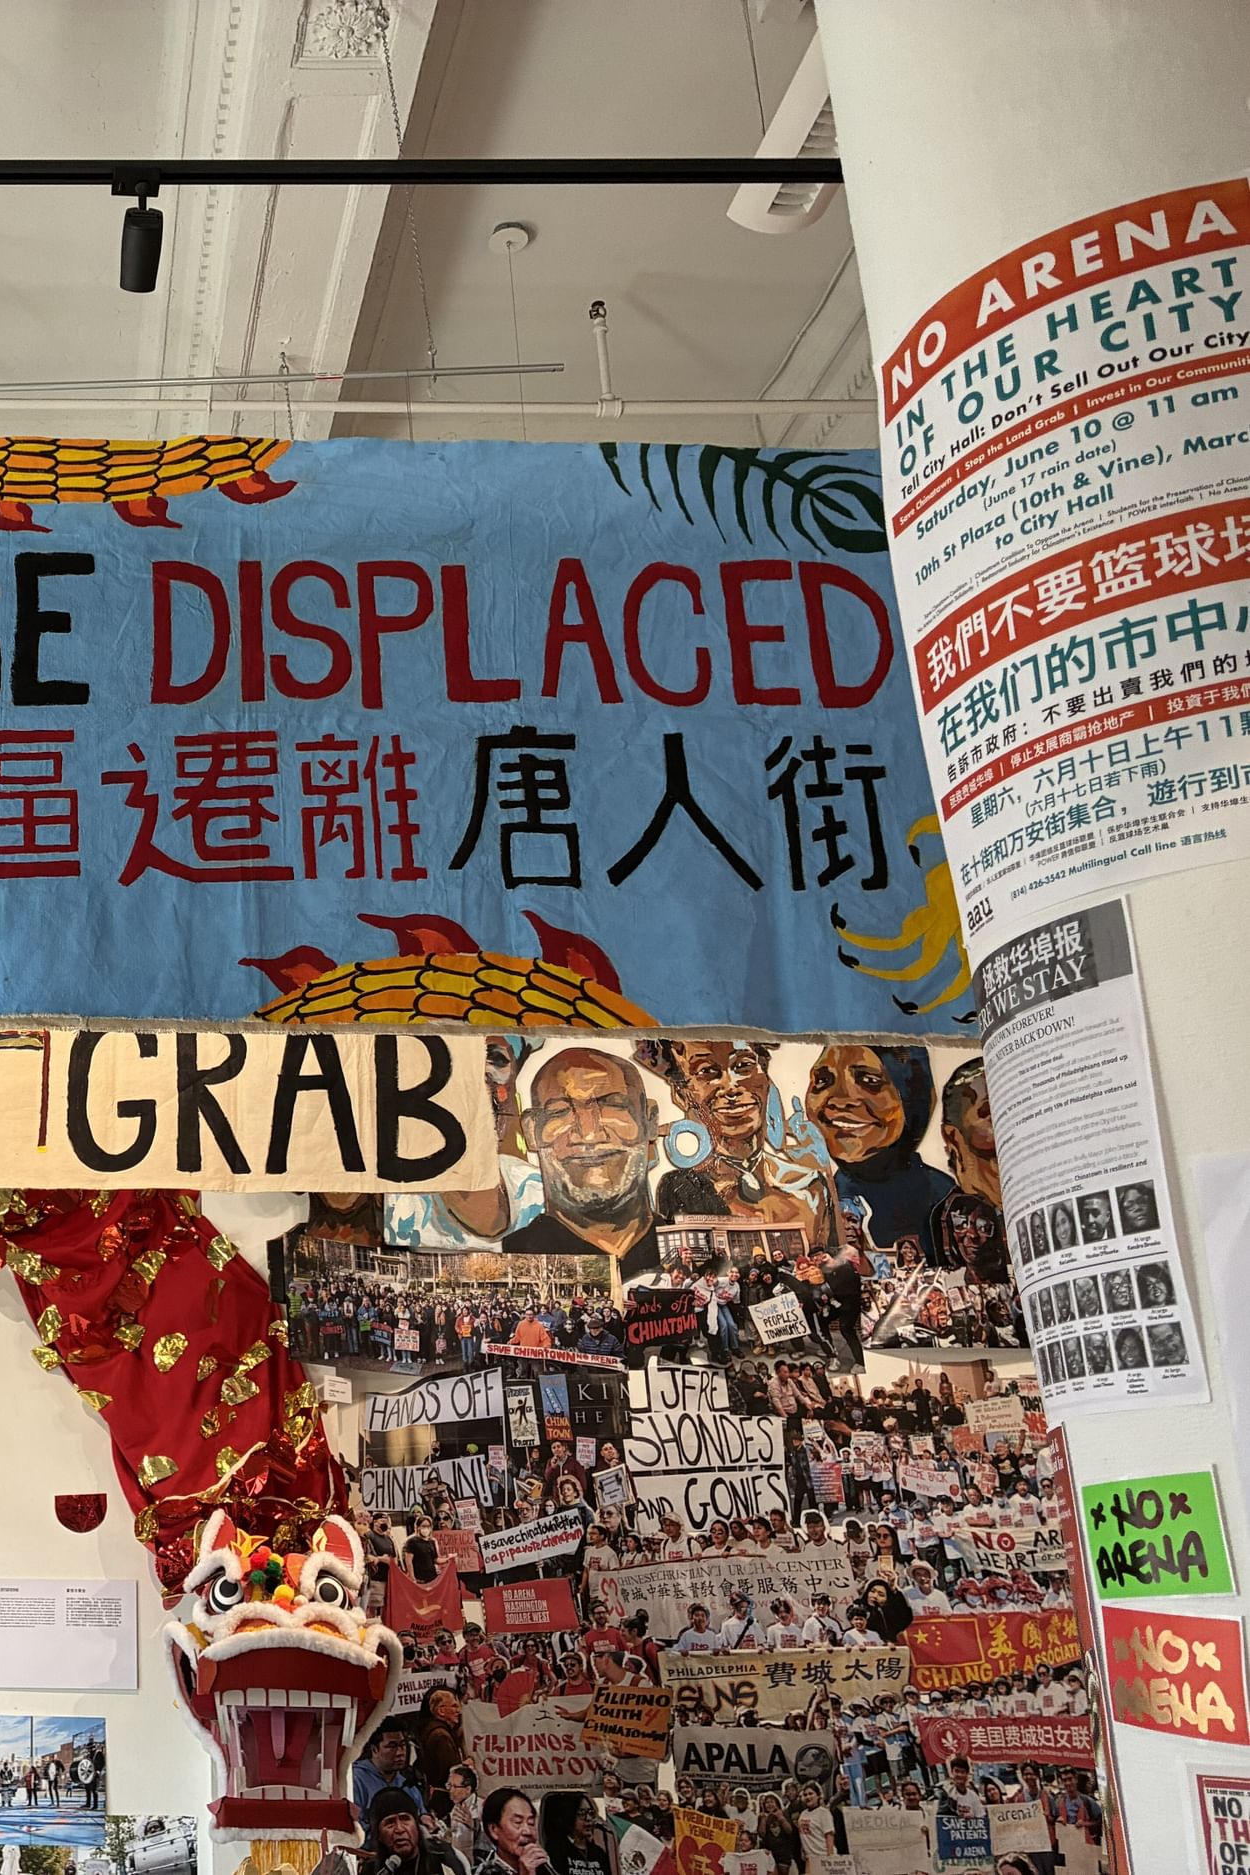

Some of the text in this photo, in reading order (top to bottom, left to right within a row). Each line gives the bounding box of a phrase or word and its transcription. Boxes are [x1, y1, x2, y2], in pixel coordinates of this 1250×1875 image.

[891, 199, 1238, 405] NO ARENA
[896, 257, 1237, 448] IN THE HEART
[900, 291, 1242, 477] OF OUR CITY
[900, 331, 1250, 500] Tell City Hall: Don't Sell Out Our City
[899, 509, 915, 526] Save
[915, 476, 952, 510] Chinatown
[964, 454, 985, 472] Stop
[987, 441, 1004, 457] the
[1005, 424, 1032, 446] Land
[1034, 410, 1066, 431] Grab
[1086, 388, 1126, 408] Invest
[1129, 383, 1142, 397] in
[1146, 375, 1173, 388] Our
[916, 386, 1239, 540] Saturday, June 10 @ 11 am
[983, 439, 1116, 512] (June 17 rain date)
[914, 424, 1250, 586] 10th St Plaza (10th & Vine), Marc
[1074, 517, 1095, 530] Arena
[1107, 503, 1138, 517] Students
[1139, 498, 1150, 509] for
[1152, 493, 1164, 504] the
[1166, 482, 1214, 499] Preservation
[1216, 478, 1224, 488] of
[1128, 504, 1157, 518] POWER
[1224, 483, 1249, 495] Arena
[995, 483, 1113, 550] to City Hall
[151, 557, 894, 711] DISPLACED
[938, 597, 1250, 758] 在我们的市中
[1068, 850, 1127, 877] Multilingual
[1130, 843, 1152, 857] Call
[1155, 840, 1177, 852] line
[993, 982, 1021, 1018] WE
[1022, 954, 1087, 1001] STAY
[1012, 1005, 1055, 1034] FOREVER!
[1014, 1030, 1038, 1050] BACK
[1037, 1016, 1076, 1041] DOWN!
[1119, 1054, 1128, 1062] up
[1104, 1084, 1124, 1096] voters
[1124, 1080, 1137, 1089] said
[67, 1029, 469, 1185] GRAB
[1135, 1158, 1148, 1167] and
[670, 1293, 692, 1314] off
[627, 1313, 698, 1345] CHINATOWN
[763, 1309, 799, 1328] PEOPLES
[763, 1320, 807, 1341] TOWNHOMES
[487, 1344, 511, 1354] SAVE
[513, 1346, 576, 1362] CHINATOWN
[591, 1355, 619, 1365] ARENA
[370, 1380, 442, 1431] HANDS
[451, 1369, 500, 1420] OFF
[545, 1415, 571, 1427] CHINA
[548, 1428, 572, 1439] TOWN
[628, 1412, 774, 1467] SHONDES
[636, 1496, 674, 1525] AND
[970, 1531, 1016, 1552] NO
[776, 1558, 846, 1574] CENTER
[976, 1550, 1039, 1571] HEART
[1096, 1531, 1209, 1589] ARENA
[502, 1588, 536, 1601] NO ARENA
[503, 1600, 548, 1613] WASHINGTON
[506, 1611, 550, 1624] SQUARE WEST
[667, 1663, 758, 1678] PHILADELPHIA
[916, 1663, 993, 1688] CHANG
[397, 1678, 447, 1694] PHILADELPHIA
[595, 1686, 672, 1707] FILIPINO
[593, 1704, 643, 1721] YOUTH
[473, 1732, 577, 1753] FILIPINOS
[583, 1719, 669, 1742] CHINATOWN
[482, 1756, 601, 1777] CHINATOW
[682, 1742, 791, 1775] APALA
[1213, 1796, 1242, 1819] NO
[942, 1818, 986, 1830] SAVE OUR
[951, 1830, 988, 1841] PATIENTS
[1220, 1842, 1249, 1866] OF
